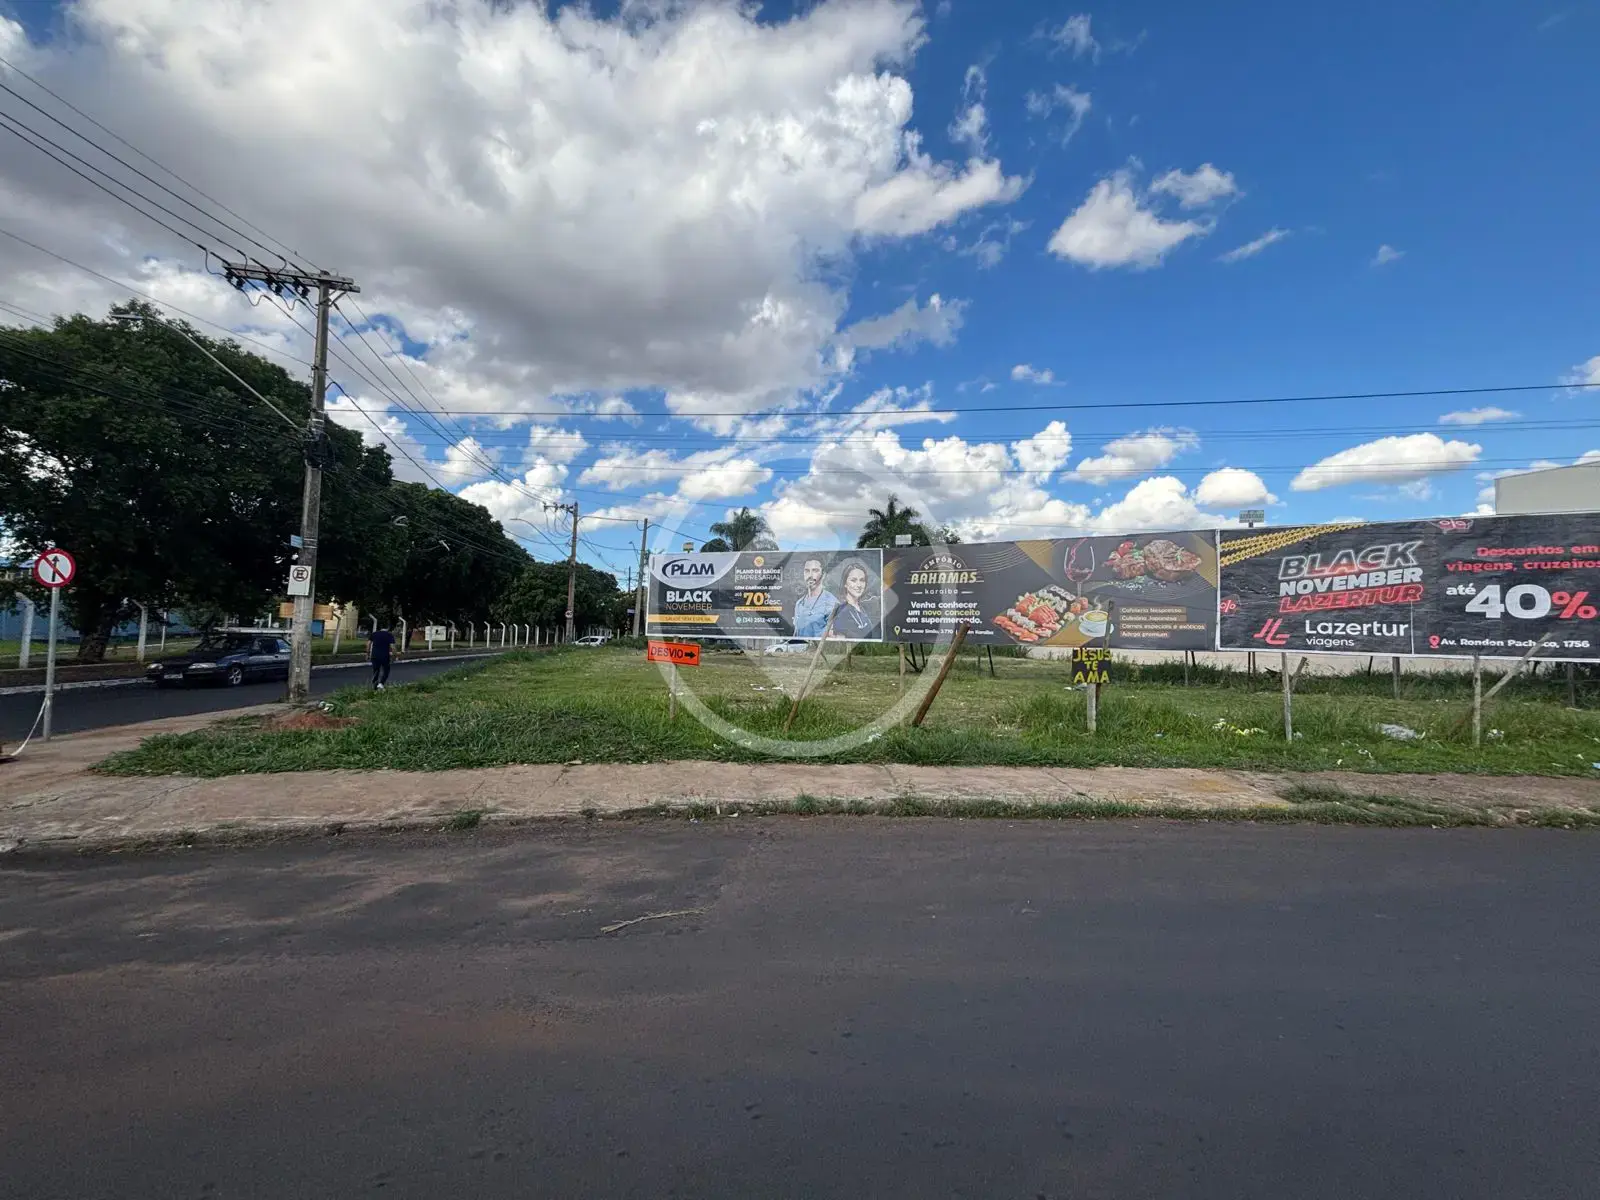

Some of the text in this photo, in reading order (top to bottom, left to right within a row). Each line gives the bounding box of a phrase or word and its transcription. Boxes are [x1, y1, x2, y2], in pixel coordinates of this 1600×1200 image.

[1476, 544, 1599, 557] Descontos em
[923, 555, 962, 570] EMPÓRIO
[1278, 540, 1424, 580] BLACK
[670, 563, 715, 576] PLAM
[1446, 561, 1518, 573] viagens,
[910, 571, 977, 584] BAHAMAS
[1278, 567, 1423, 597] NOVEMBER
[666, 590, 713, 603] BLACK
[1279, 584, 1424, 614] LAZERTUR
[1446, 583, 1597, 619] até 40%
[665, 602, 713, 611] NOVEMBER
[910, 601, 978, 609] Venha conhecer
[944, 608, 981, 616] conceito
[1305, 620, 1409, 637] Lazertur
[1305, 637, 1355, 648] viagens
[1440, 638, 1591, 649] Av. Rondon Pachco, 1756
[650, 646, 684, 659] DESVIO
[1073, 647, 1111, 661] JESUS
[1083, 660, 1099, 670] TE
[1073, 670, 1110, 683] AMA
